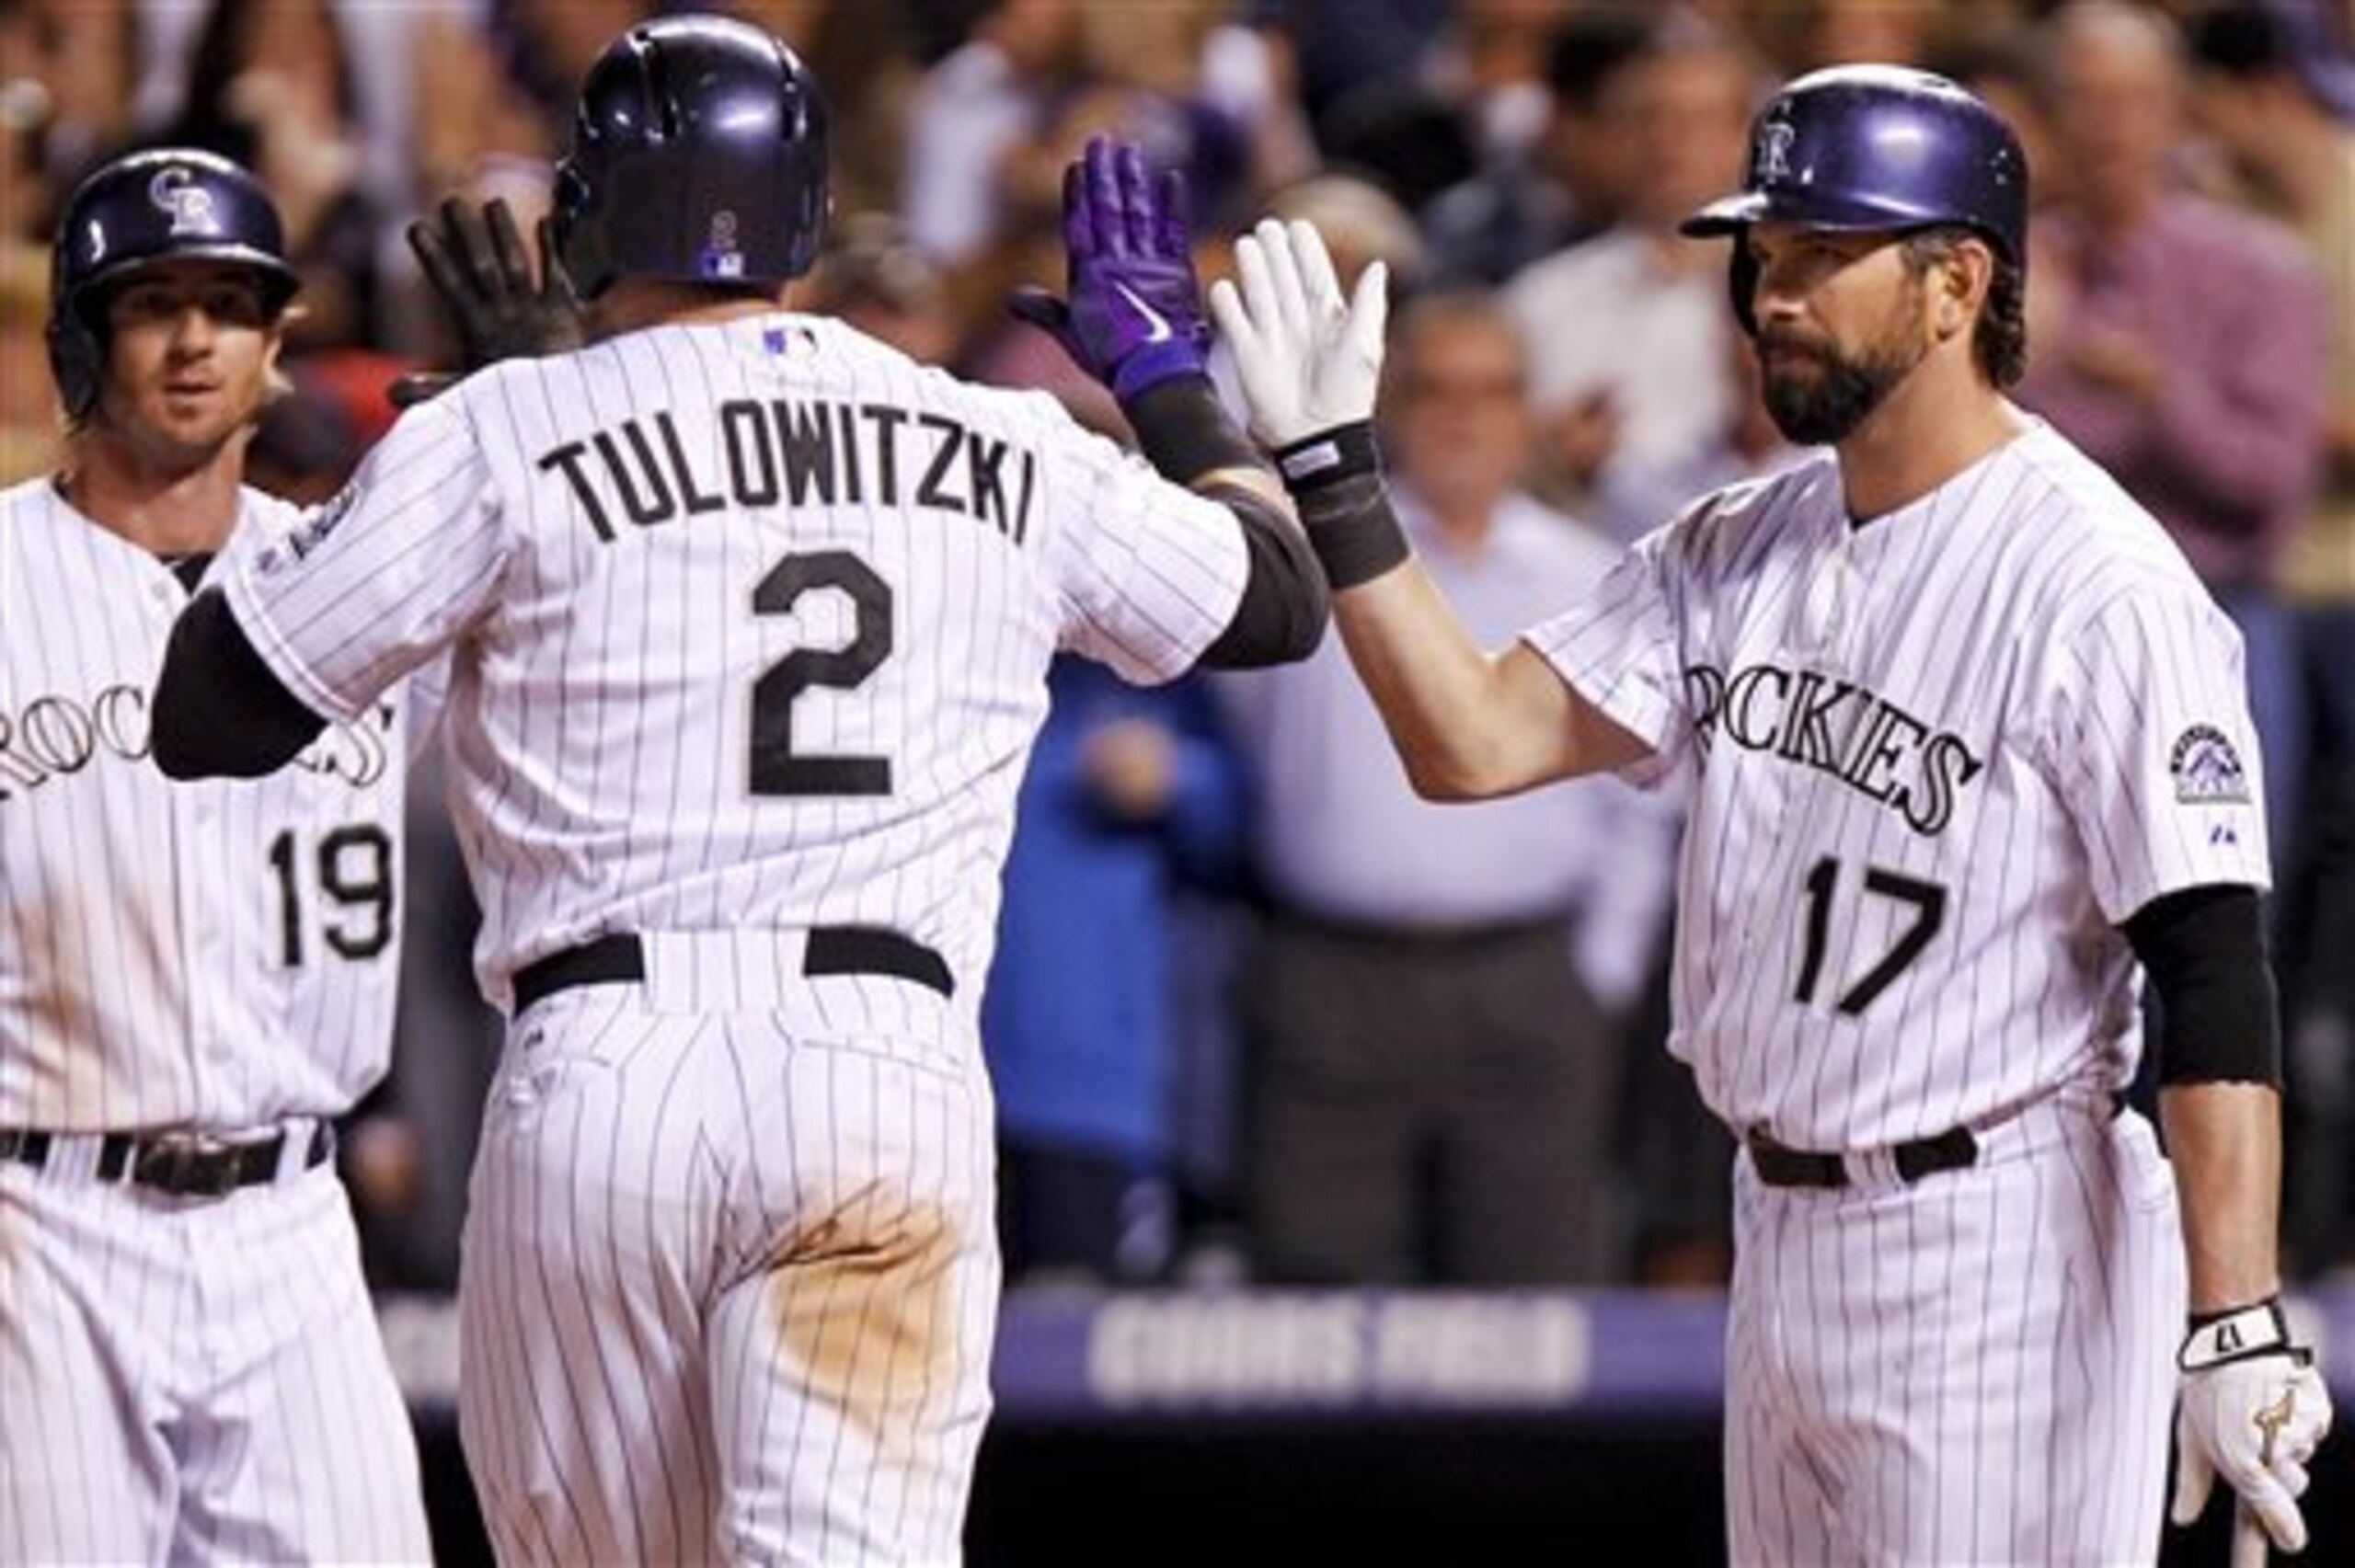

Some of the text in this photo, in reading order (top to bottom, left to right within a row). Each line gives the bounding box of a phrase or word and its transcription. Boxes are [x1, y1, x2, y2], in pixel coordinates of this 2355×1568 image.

[537, 399, 1036, 547] TULOWITZKI
[749, 550, 893, 795] 2
[270, 822, 393, 967] 19
[1795, 854, 1947, 1016] 17
